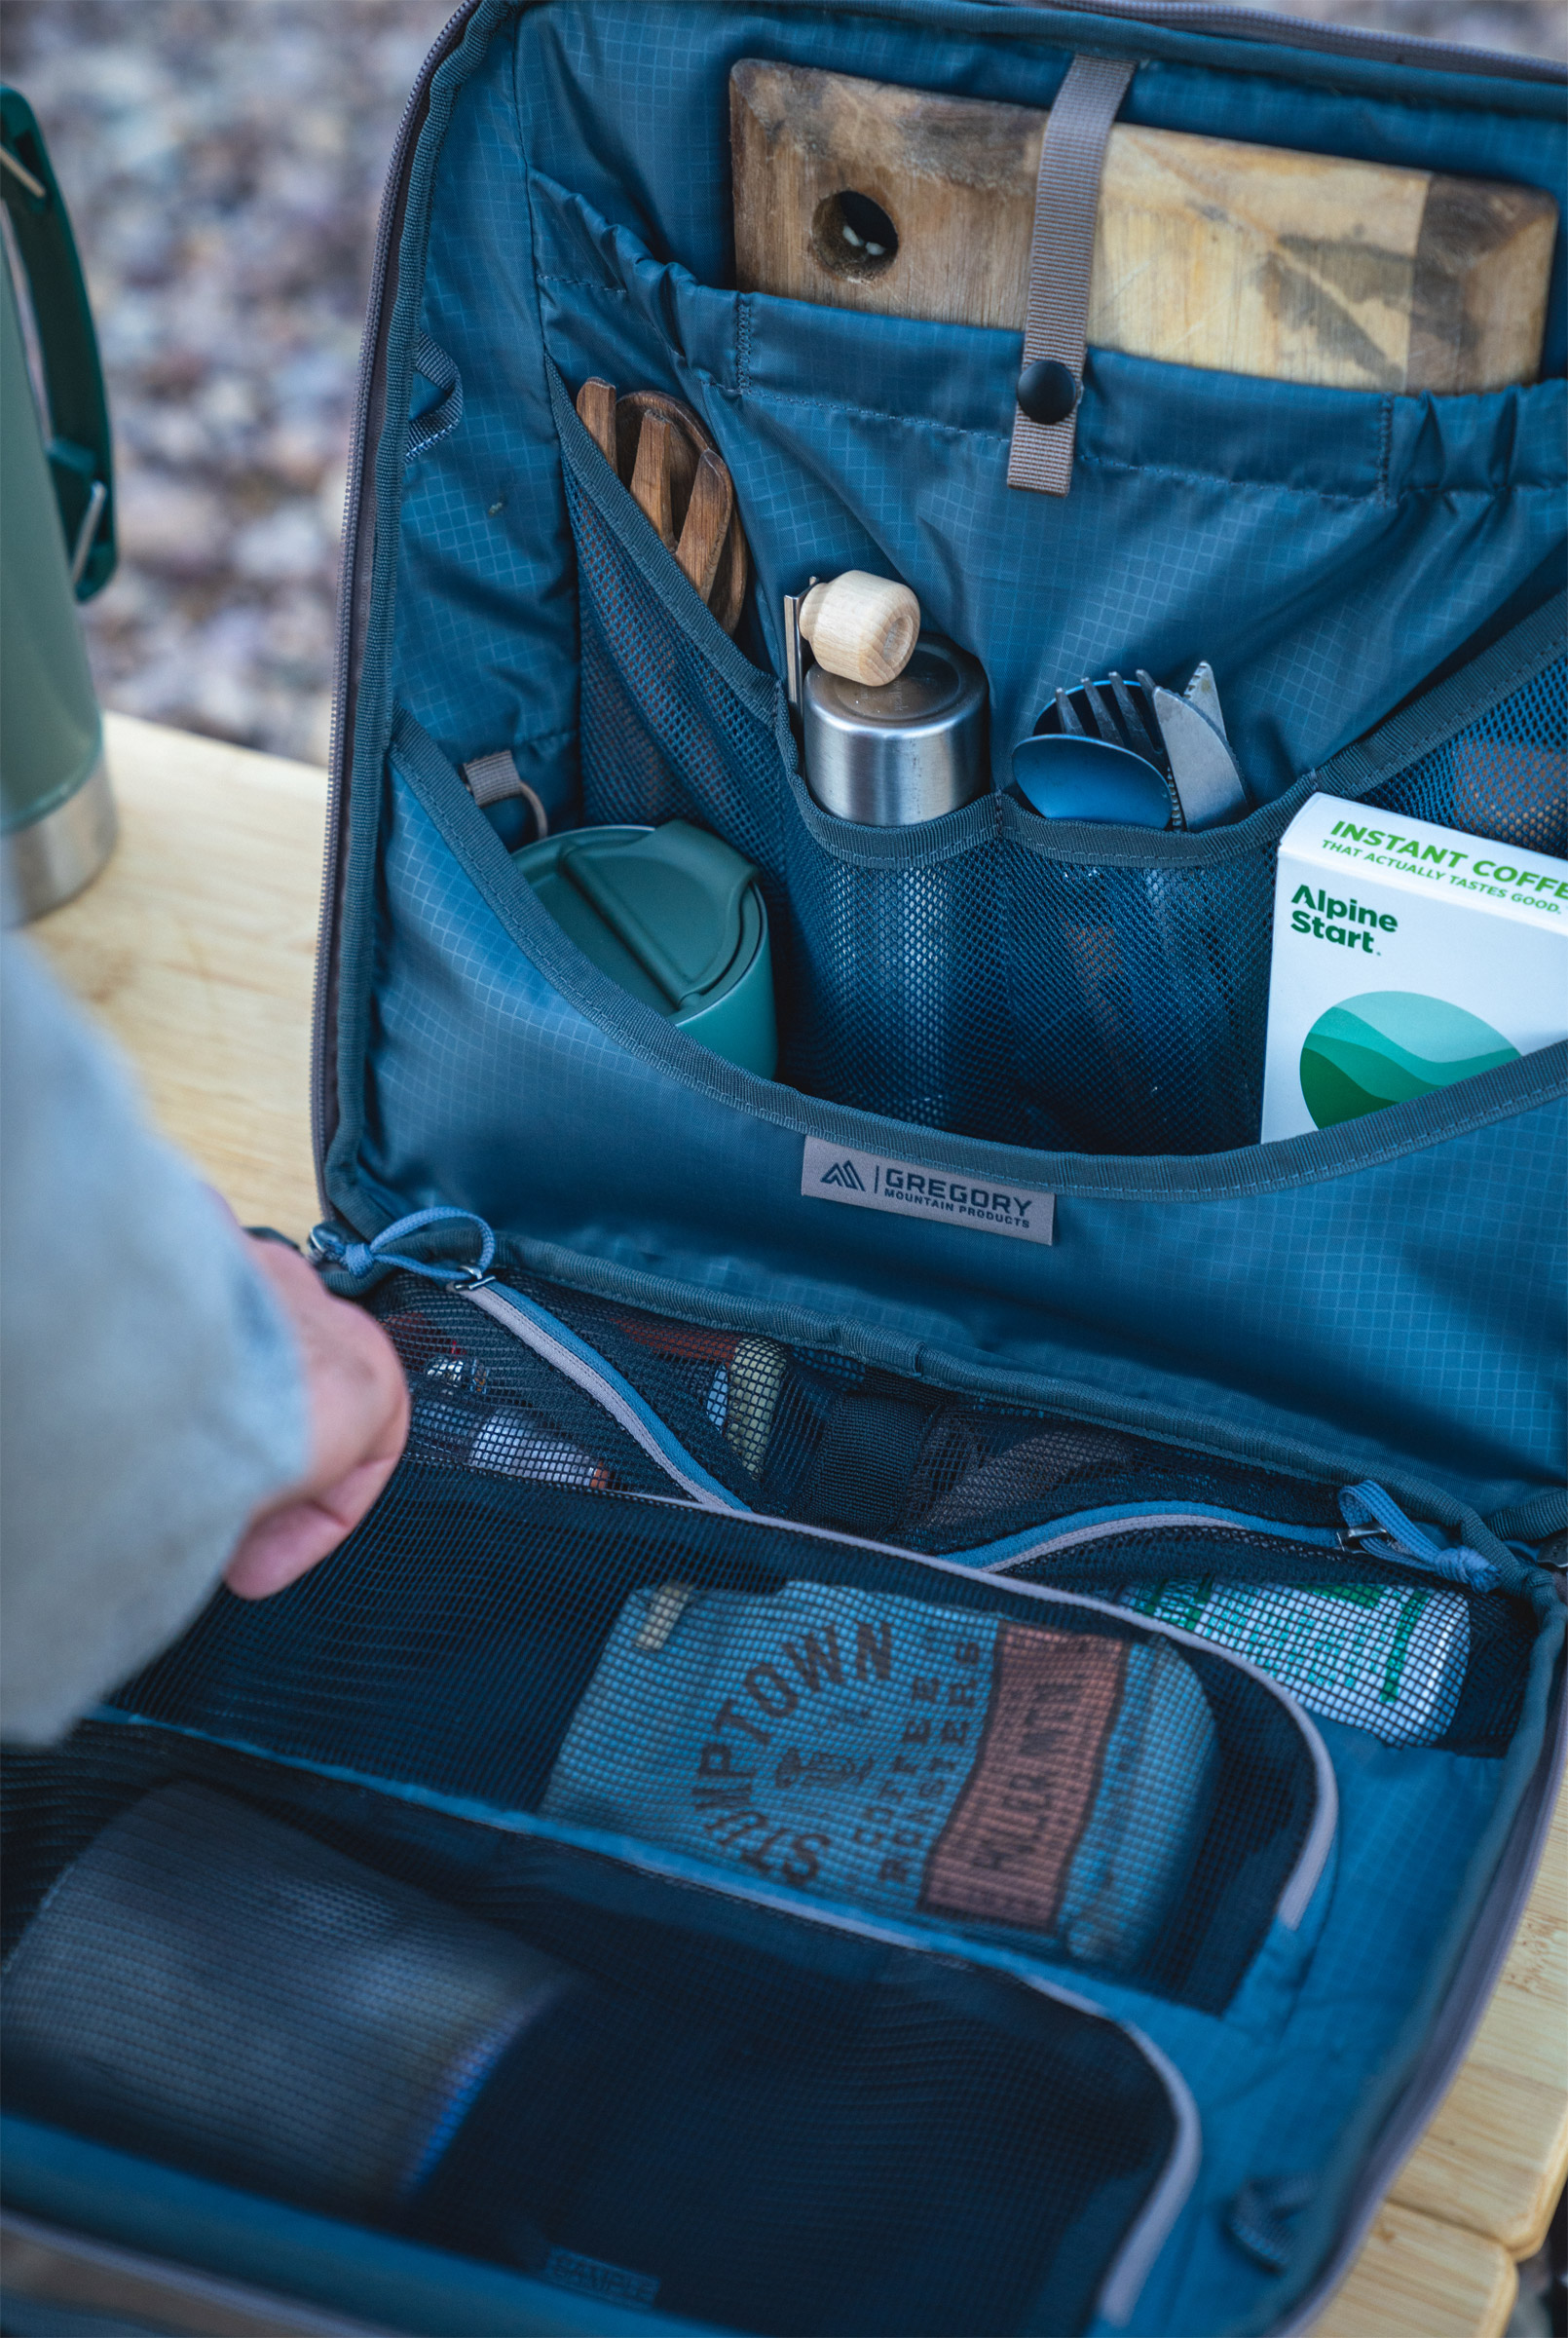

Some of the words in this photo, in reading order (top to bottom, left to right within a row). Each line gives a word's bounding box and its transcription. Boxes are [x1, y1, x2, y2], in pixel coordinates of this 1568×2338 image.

[1329, 820, 1469, 868] INSTANT
[1290, 884, 1399, 933] Alpine
[1322, 840, 1363, 857] THAT
[1363, 852, 1446, 881] ACTUALLY
[1450, 875, 1508, 898] TASTES
[1511, 892, 1561, 915] GOOD.
[883, 1188, 954, 1212] MOUNTAIN
[958, 1204, 1030, 1229] PRODUCTS
[885, 1168, 1033, 1217] GREGORY
[691, 1622, 892, 1886] STUMPTOWN
[852, 1675, 941, 1847] COFFEE
[878, 1640, 981, 1884] ROASTERS
